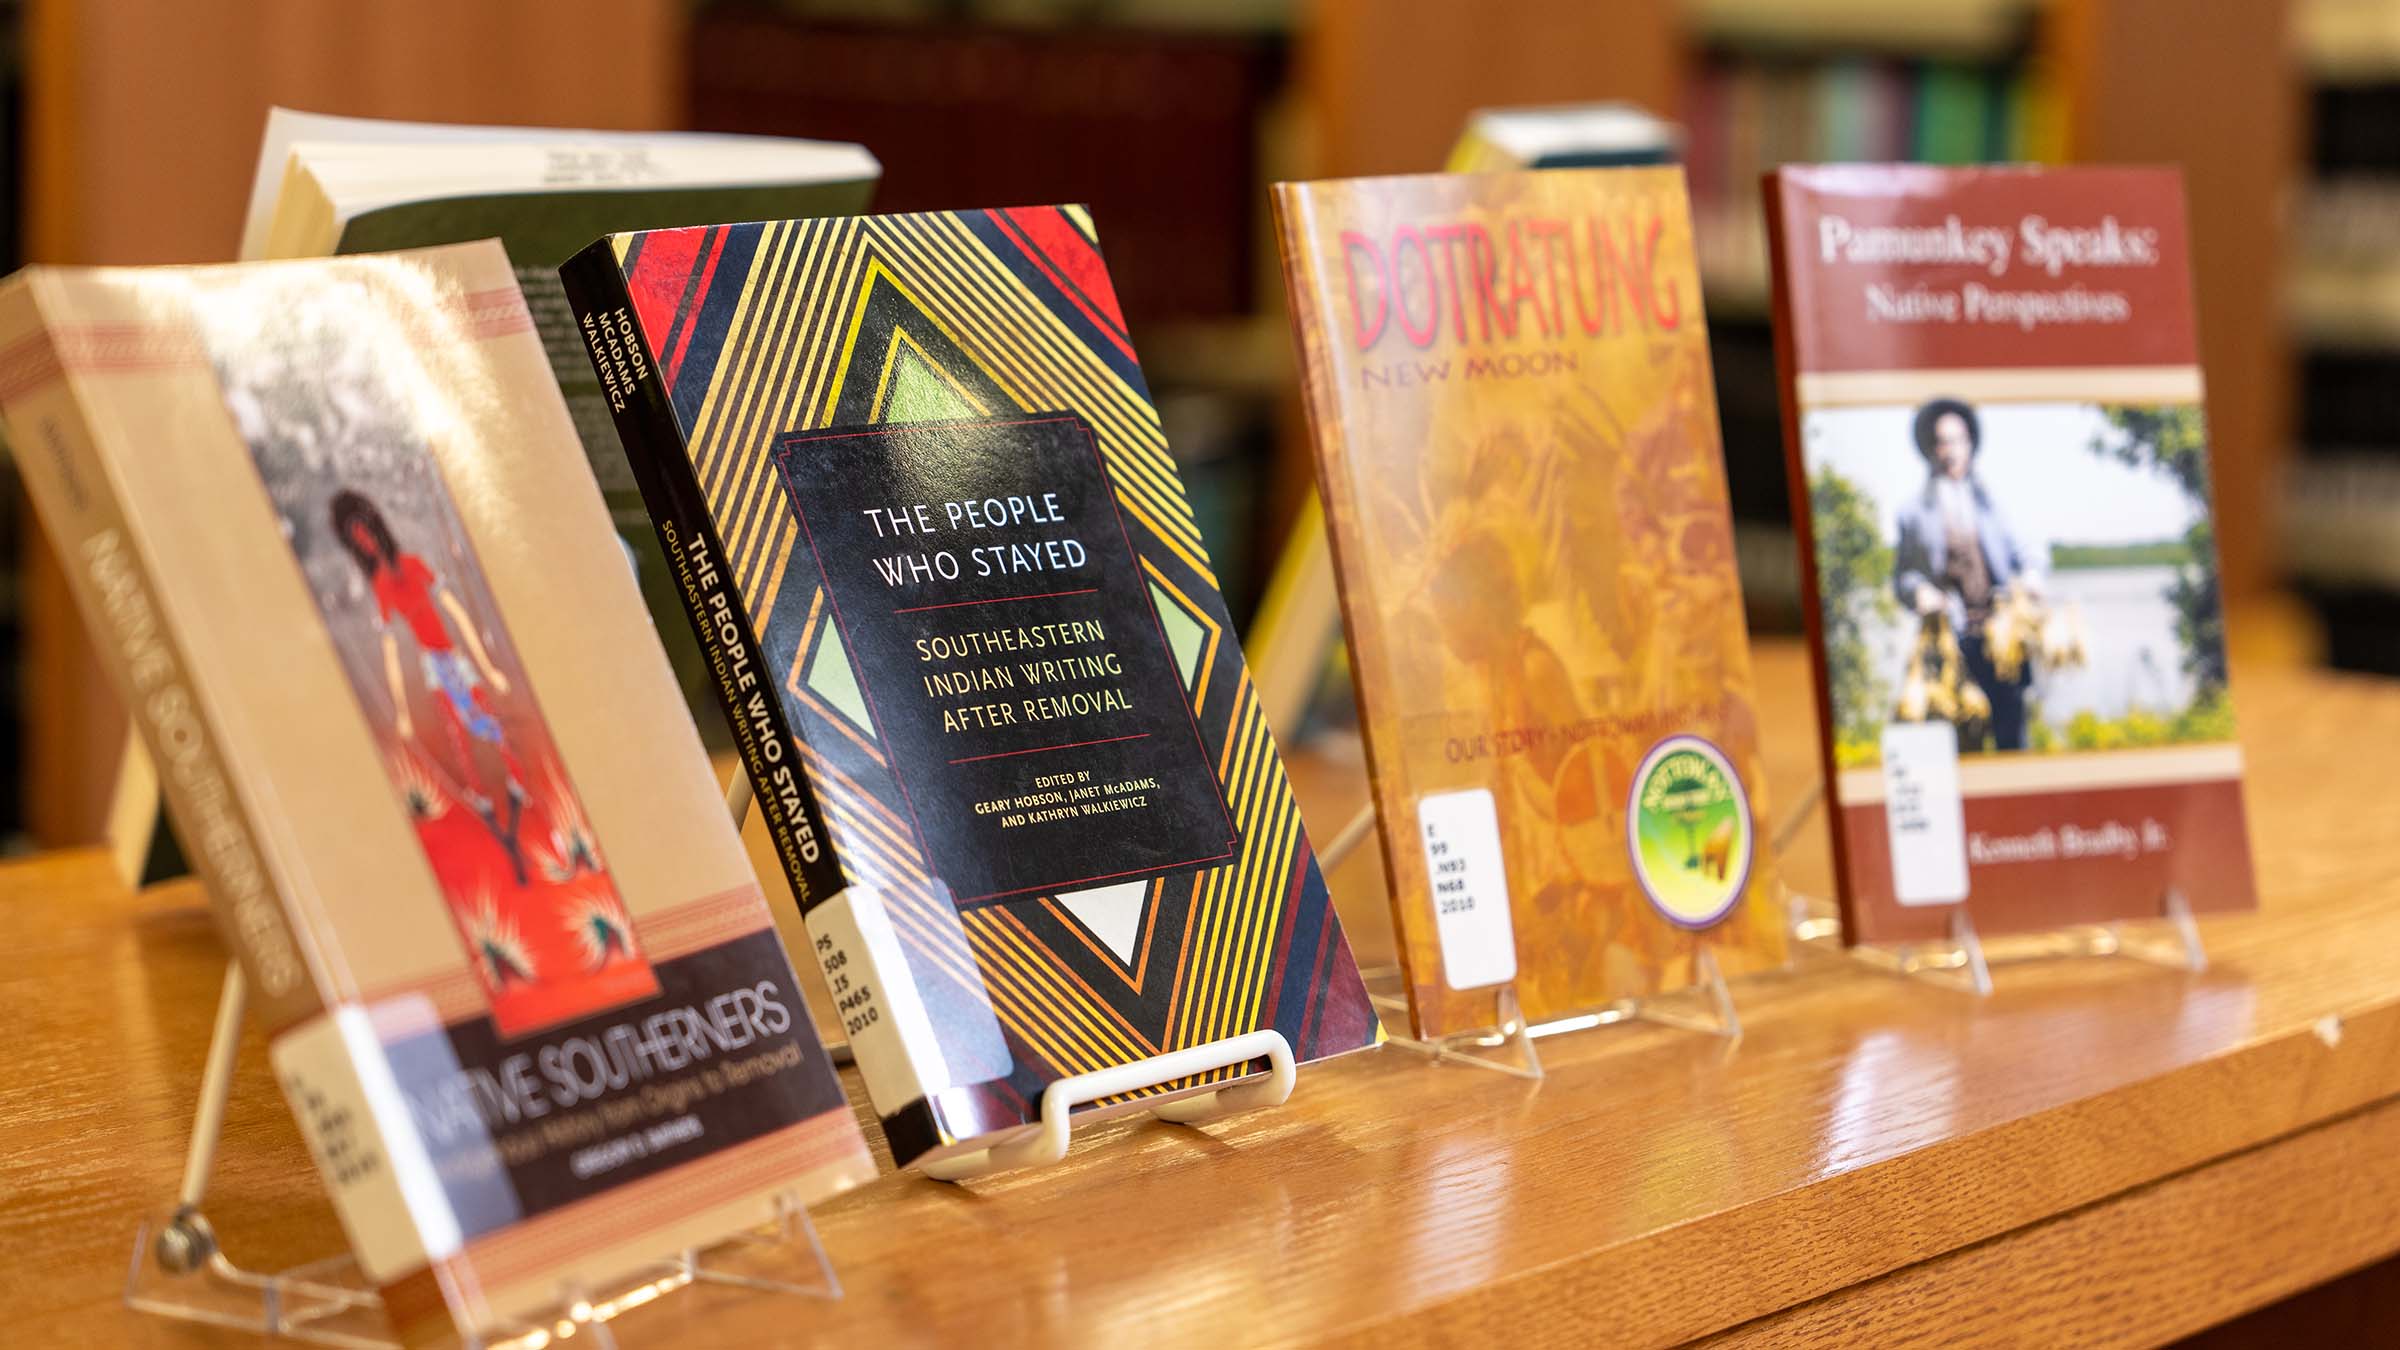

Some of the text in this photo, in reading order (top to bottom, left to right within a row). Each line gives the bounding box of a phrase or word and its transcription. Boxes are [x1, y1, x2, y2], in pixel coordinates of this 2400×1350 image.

[1818, 214, 2160, 277] Pamunkey Speaks:
[1340, 214, 1682, 353] DOTRATUNG
[1865, 281, 2131, 331] Native Perspectives
[583, 312, 626, 414] WALKIEWICZ
[598, 312, 636, 395] MCADAMS
[614, 307, 649, 380] HOBSON
[1361, 349, 1580, 390] NEW MOON
[863, 493, 1065, 538] THE PEOPLE
[872, 539, 1087, 587] WHO STAYED
[915, 619, 1106, 661] SOUTHEASTERN
[688, 532, 819, 863] THE PEOPLE WHO STAYED
[924, 653, 1123, 698] INDIAN WRITING
[662, 519, 811, 902] SOUTHEASTERN INDIAN WRITING AFTER REMOVAL
[943, 688, 1133, 733] AFTER REMOVAL
[1445, 735, 1489, 763] OUR
[974, 800, 1012, 815] GEARY
[1014, 791, 1068, 808] HOBSON,
[1068, 786, 1101, 803] JANET
[1035, 770, 1091, 789] EDITED BY
[1001, 796, 1148, 829] AND KATHRYN WALKIEWICZ
[815, 932, 833, 953] PS
[824, 950, 847, 974] 508
[838, 986, 872, 1015] P465
[847, 1006, 879, 1036] 2010
[538, 980, 792, 1108] SOUTHERNERS
